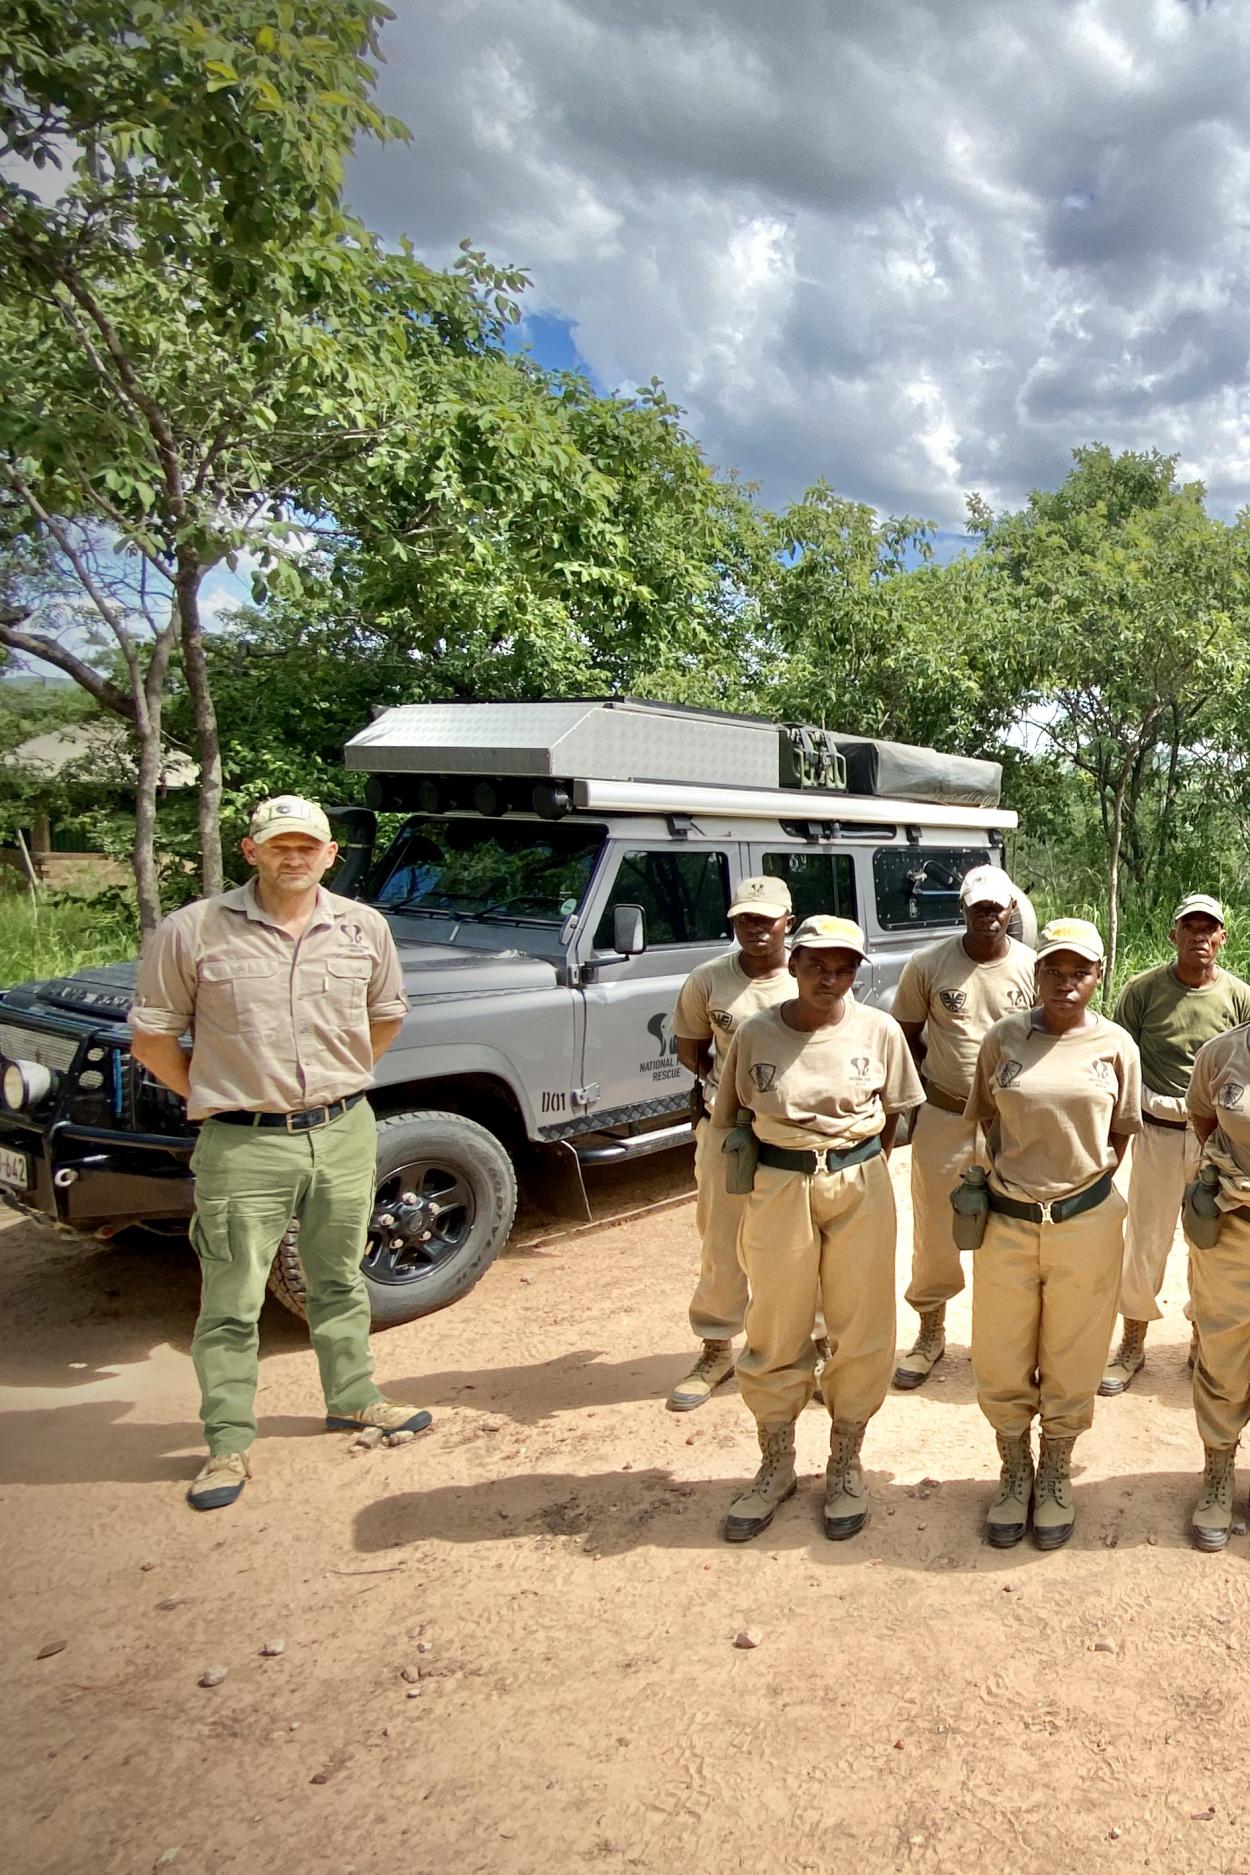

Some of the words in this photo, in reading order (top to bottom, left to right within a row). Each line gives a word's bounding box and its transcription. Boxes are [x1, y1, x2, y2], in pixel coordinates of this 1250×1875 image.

[640, 1057, 675, 1073] NATIONAL
[653, 1067, 681, 1081] RESCUE
[0, 1151, 26, 1183] -642
